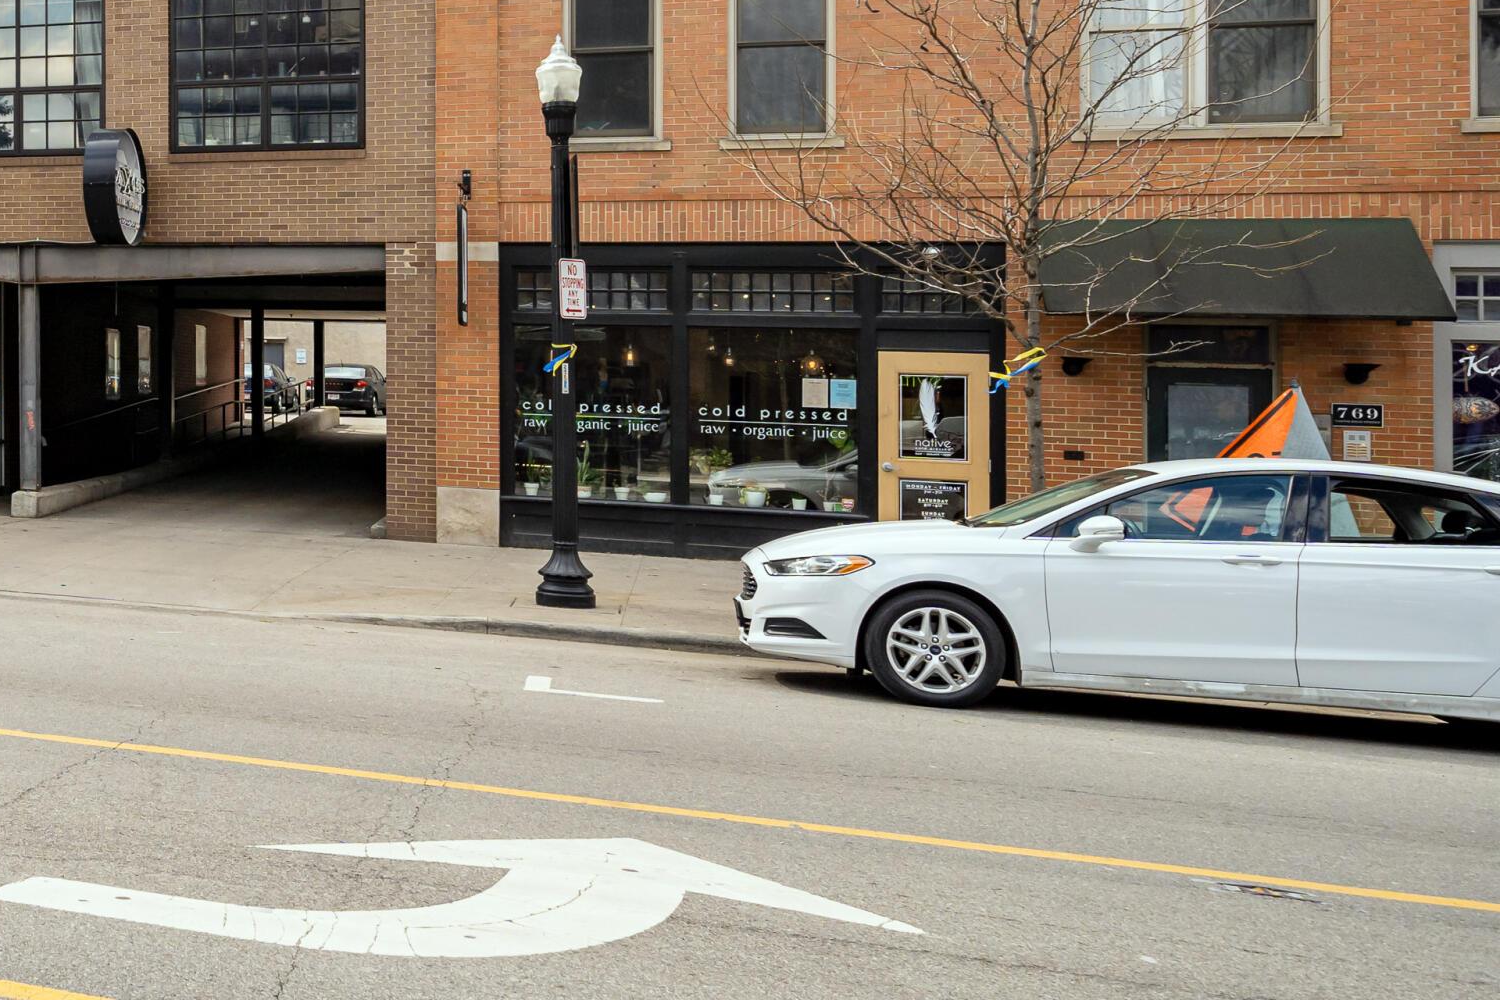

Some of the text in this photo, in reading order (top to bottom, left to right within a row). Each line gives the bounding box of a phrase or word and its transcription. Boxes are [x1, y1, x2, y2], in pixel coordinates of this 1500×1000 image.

[567, 264, 578, 276] NO
[562, 277, 584, 290] STOPPING
[568, 290, 579, 298] ANY
[567, 299, 580, 307] TIME
[522, 399, 661, 415] col pressed
[698, 404, 848, 422] cold pressed
[1336, 406, 1379, 420] 769
[524, 418, 660, 434] raw ganic juice
[700, 424, 847, 442] raw organic juice
[915, 438, 952, 448] native
